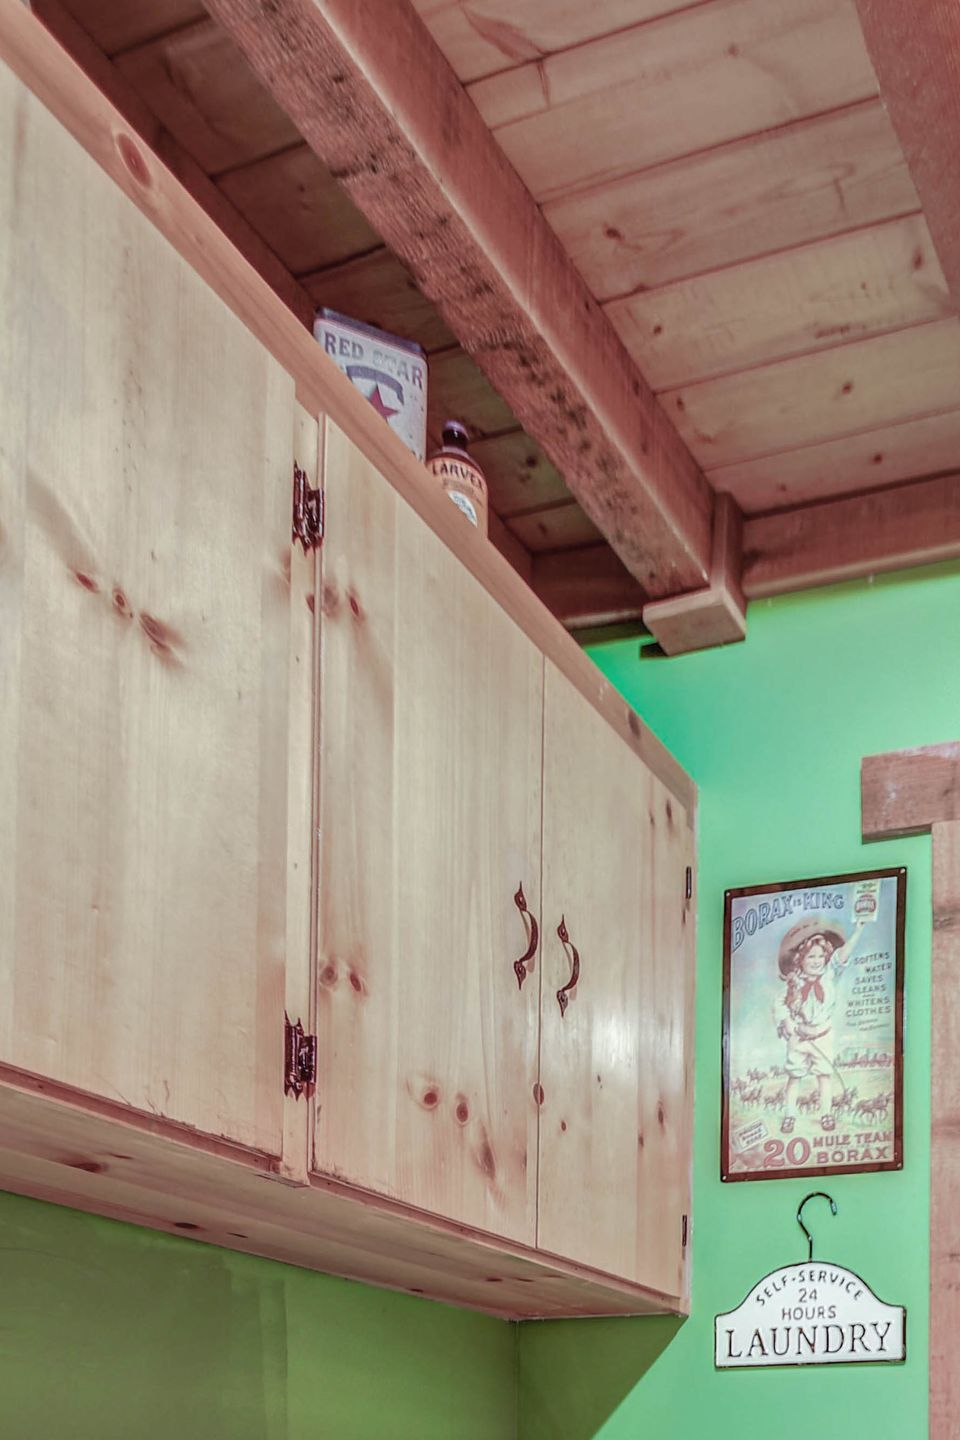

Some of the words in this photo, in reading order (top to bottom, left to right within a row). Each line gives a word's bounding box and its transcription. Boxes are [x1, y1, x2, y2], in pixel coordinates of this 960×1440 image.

[325, 331, 364, 359] RED
[372, 350, 423, 390] STAR
[732, 895, 793, 952] BORAX
[803, 892, 845, 911] KING
[854, 952, 890, 965] SOFTENS
[865, 962, 892, 973] WATER
[855, 975, 883, 984] SAVES
[852, 984, 886, 994] CLEANS
[848, 996, 890, 1007] WHITENS
[846, 1006, 891, 1017] CLOTHES
[813, 1134, 851, 1147] MULE
[855, 1131, 893, 1143] TEAM
[763, 1137, 810, 1168] 20
[816, 1146, 888, 1163] BORAX
[756, 1270, 863, 1306] SELF-SERVICE
[798, 1288, 818, 1303] 24
[781, 1305, 837, 1321] HOURS
[725, 1322, 892, 1359] LAUNDRY
